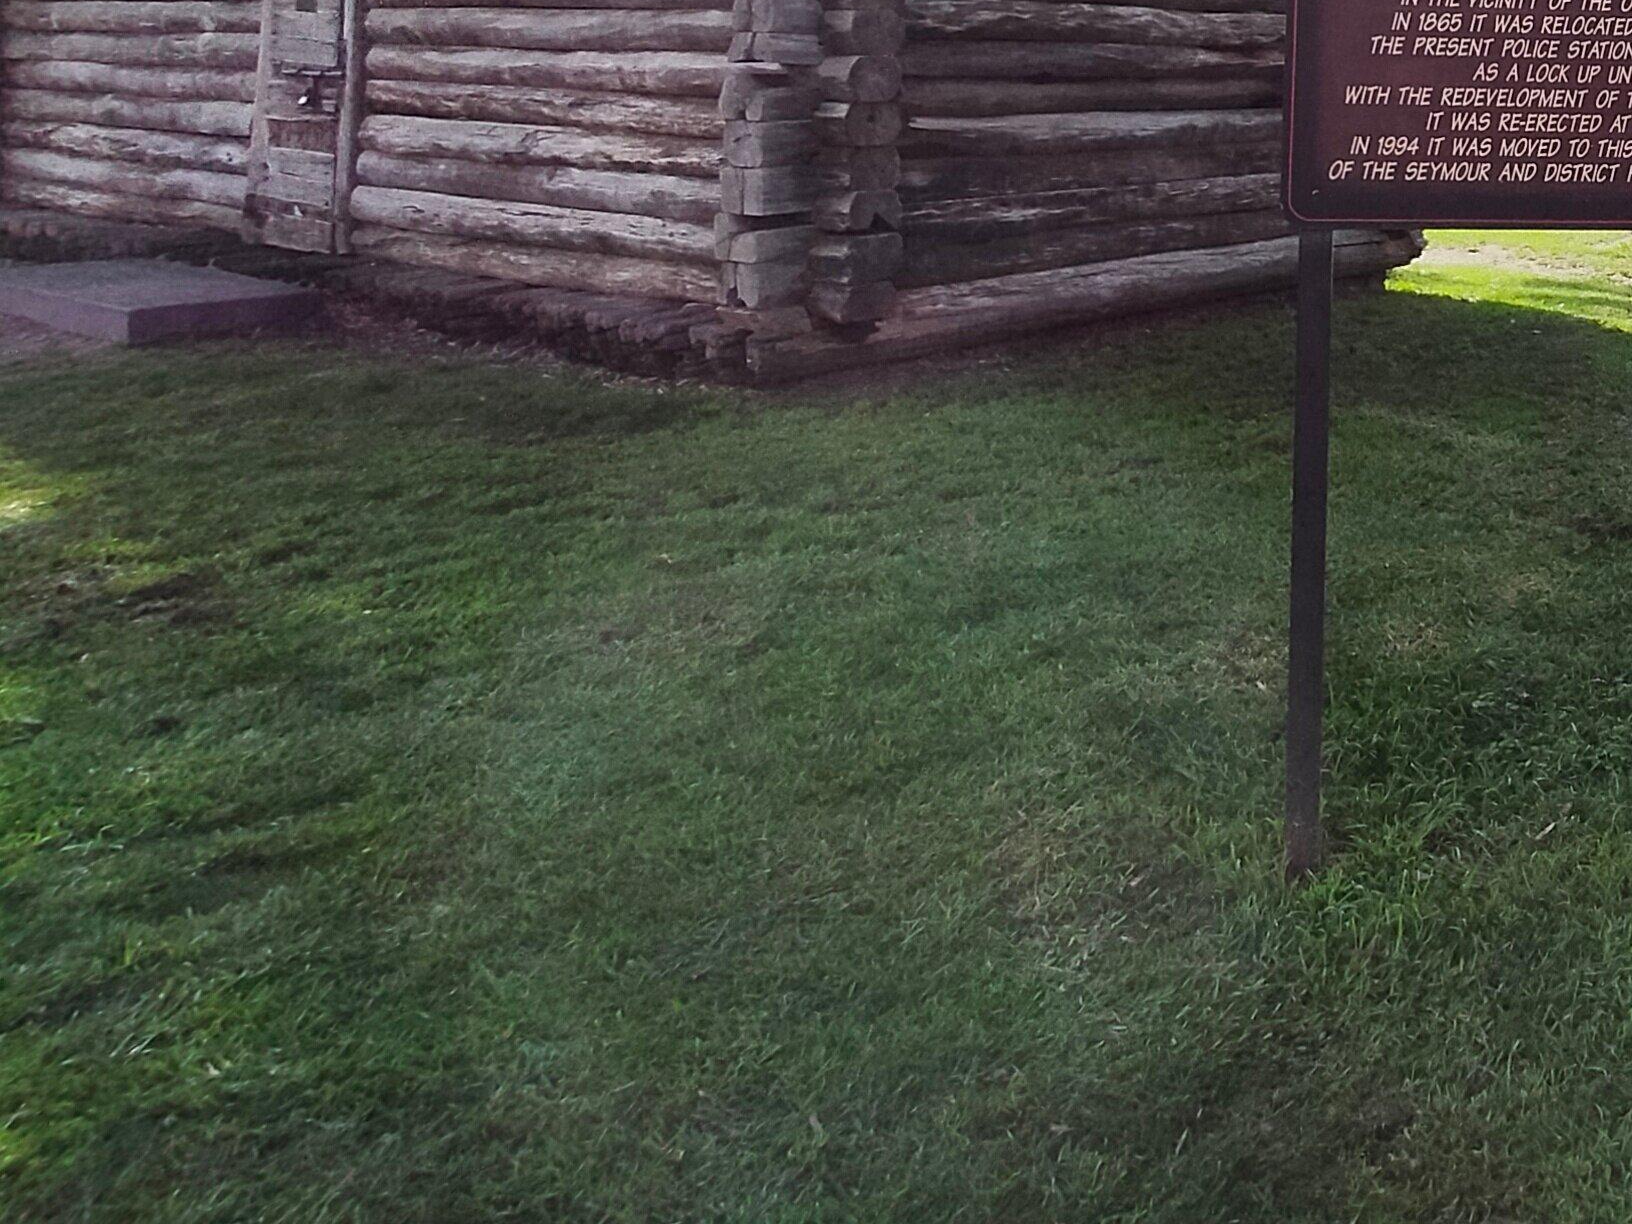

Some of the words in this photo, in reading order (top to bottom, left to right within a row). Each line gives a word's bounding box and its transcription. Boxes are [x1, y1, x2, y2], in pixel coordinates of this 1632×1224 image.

[1391, 11, 1412, 31] IN
[1418, 12, 1463, 33] 1865
[1469, 13, 1488, 33] IT
[1494, 14, 1534, 34] WAS
[1371, 35, 1406, 55] THE
[1412, 36, 1495, 57] PRESENT
[1501, 38, 1561, 59] POLICE
[1472, 62, 1499, 82] AS
[1505, 62, 1519, 82] A
[1525, 63, 1571, 83] LOCK
[1577, 64, 1602, 84] UP
[1344, 85, 1392, 105] WITH
[1398, 85, 1434, 106] THE
[1440, 87, 1589, 109] REDEVELOPMENT
[1595, 89, 1620, 109] OF
[1425, 111, 1445, 131] IT
[1451, 111, 1491, 132] WAS
[1497, 112, 1603, 133] RE-ERECTED
[1608, 114, 1632, 134] AT
[1349, 135, 1371, 155] IN
[1377, 136, 1420, 156] 1994
[1426, 136, 1446, 156] IT
[1452, 137, 1492, 157] WAS
[1498, 137, 1561, 158] MOVED
[1568, 138, 1591, 158] TO
[1328, 159, 1355, 180] OF
[1362, 160, 1398, 181] THE
[1404, 161, 1492, 182] SEYMOUR
[1498, 162, 1537, 182] AND
[1543, 163, 1621, 183] DISTRICT
